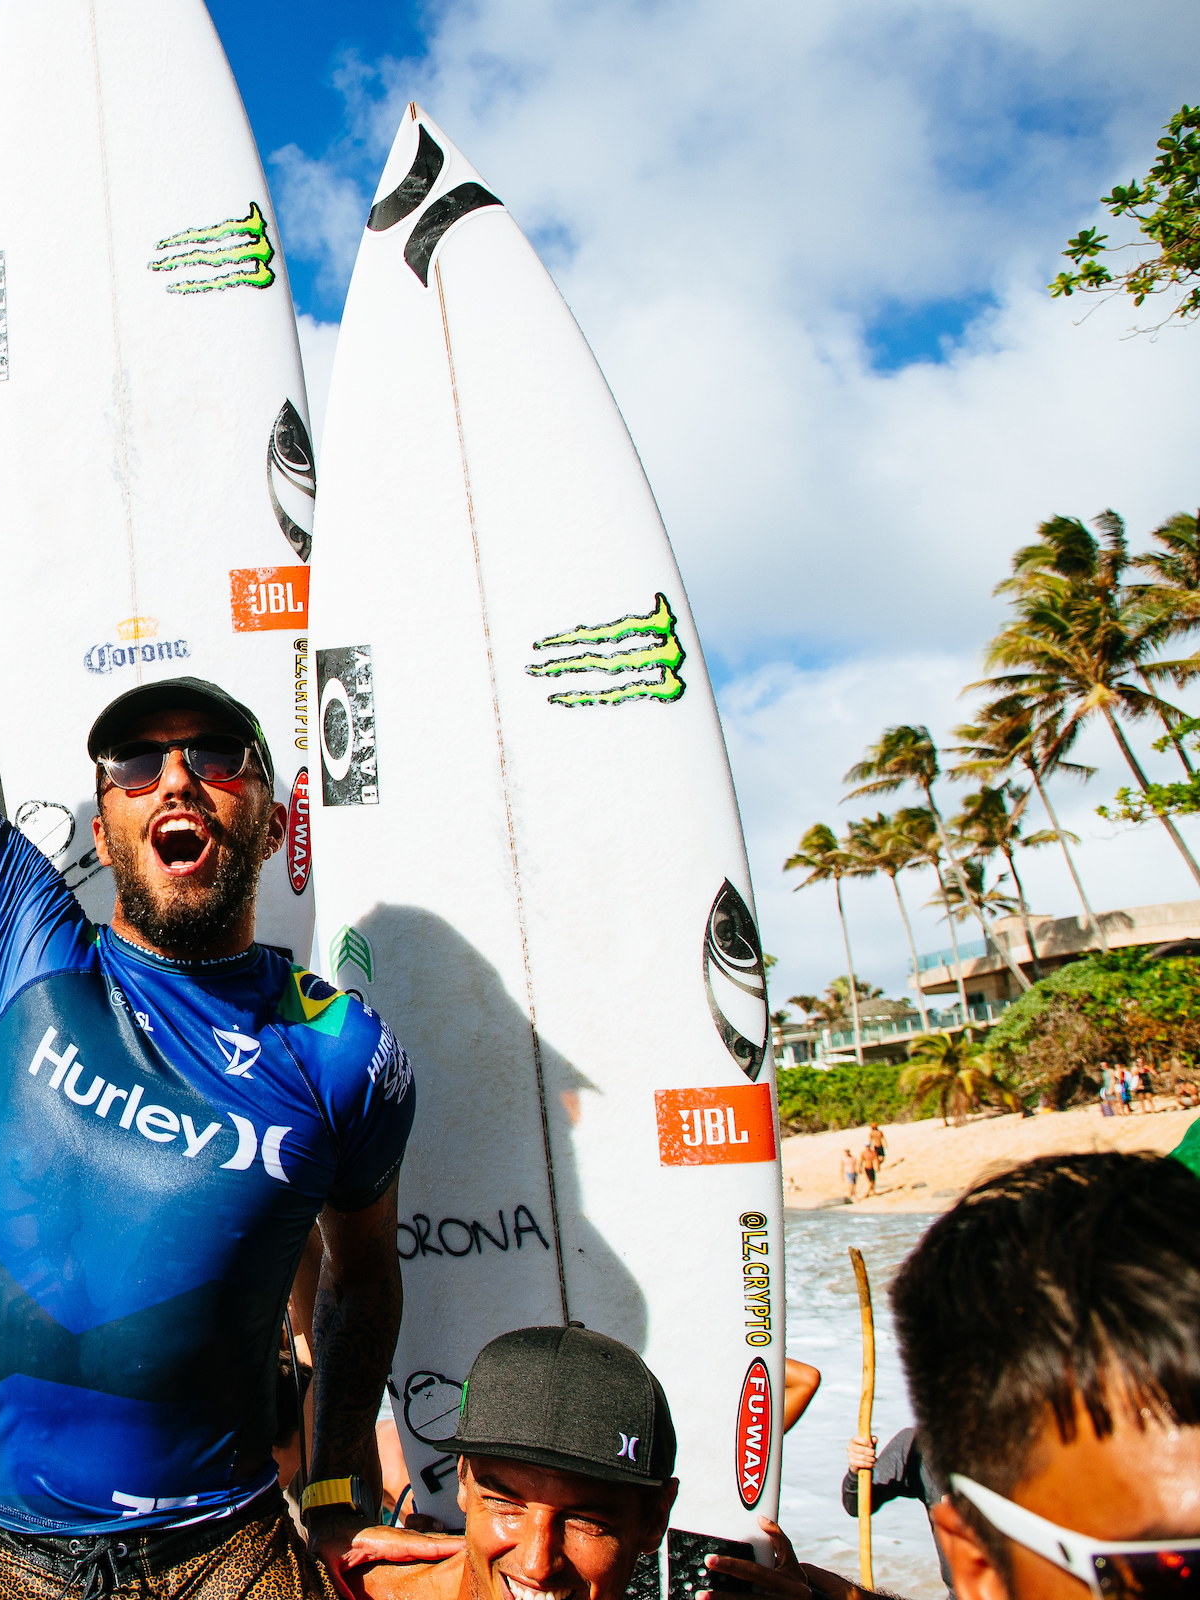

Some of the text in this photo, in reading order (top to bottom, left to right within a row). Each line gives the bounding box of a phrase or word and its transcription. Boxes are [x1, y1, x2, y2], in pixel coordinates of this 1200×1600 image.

[250, 582, 304, 615] JBL
[84, 638, 191, 675] Corona
[354, 650, 378, 804] OAKLEY
[28, 1026, 222, 1158] Hurley
[680, 1106, 750, 1147] JBL
[397, 1204, 550, 1260] ORONA
[738, 1211, 772, 1347] @LZ.CRYPTO
